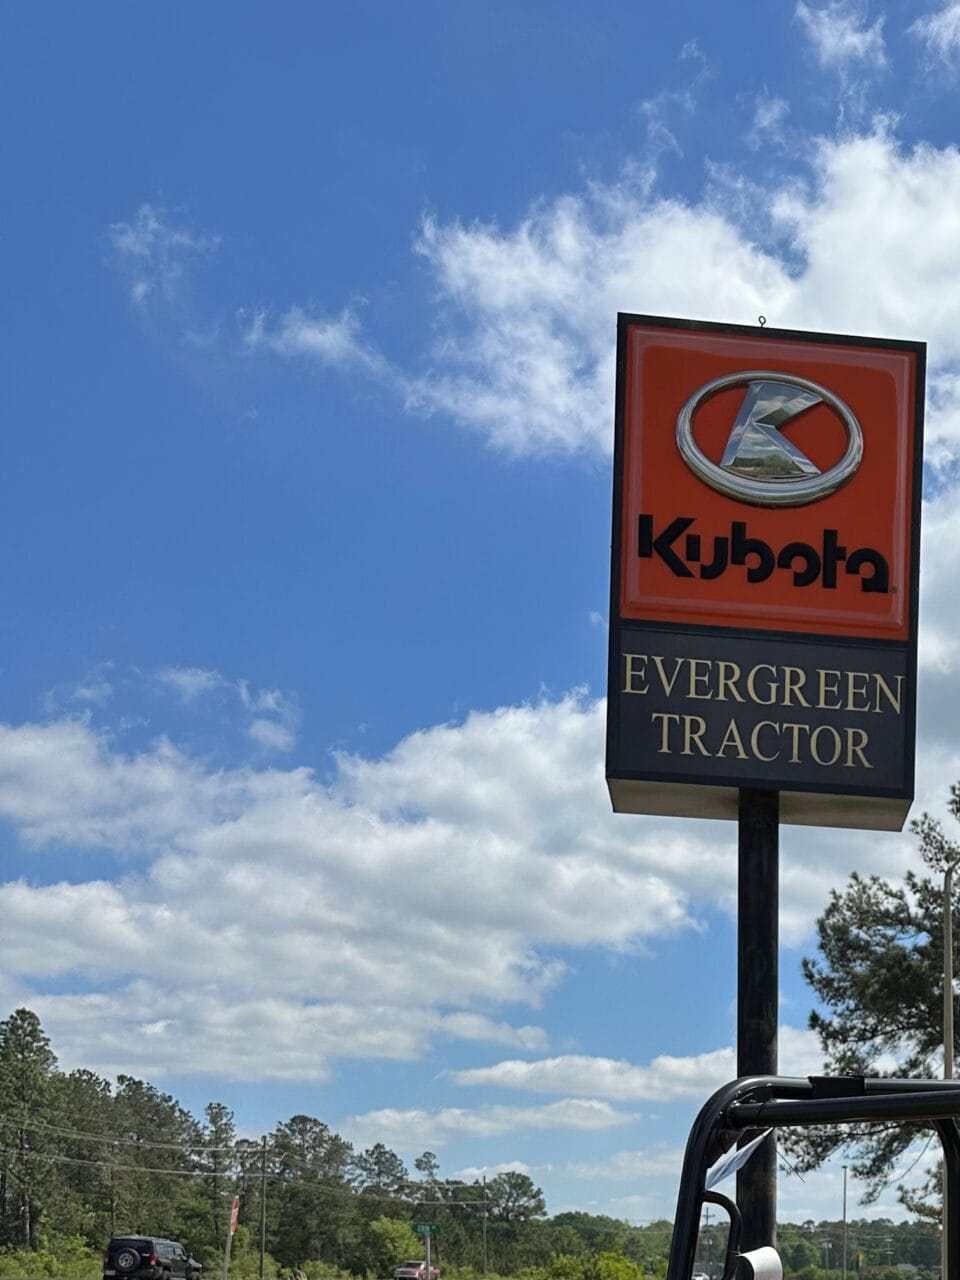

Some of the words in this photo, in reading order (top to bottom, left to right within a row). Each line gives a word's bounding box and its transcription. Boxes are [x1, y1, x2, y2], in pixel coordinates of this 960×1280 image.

[638, 513, 892, 594] Kubota
[621, 653, 905, 716] EVERGREEN
[651, 712, 874, 769] TRACTOR
